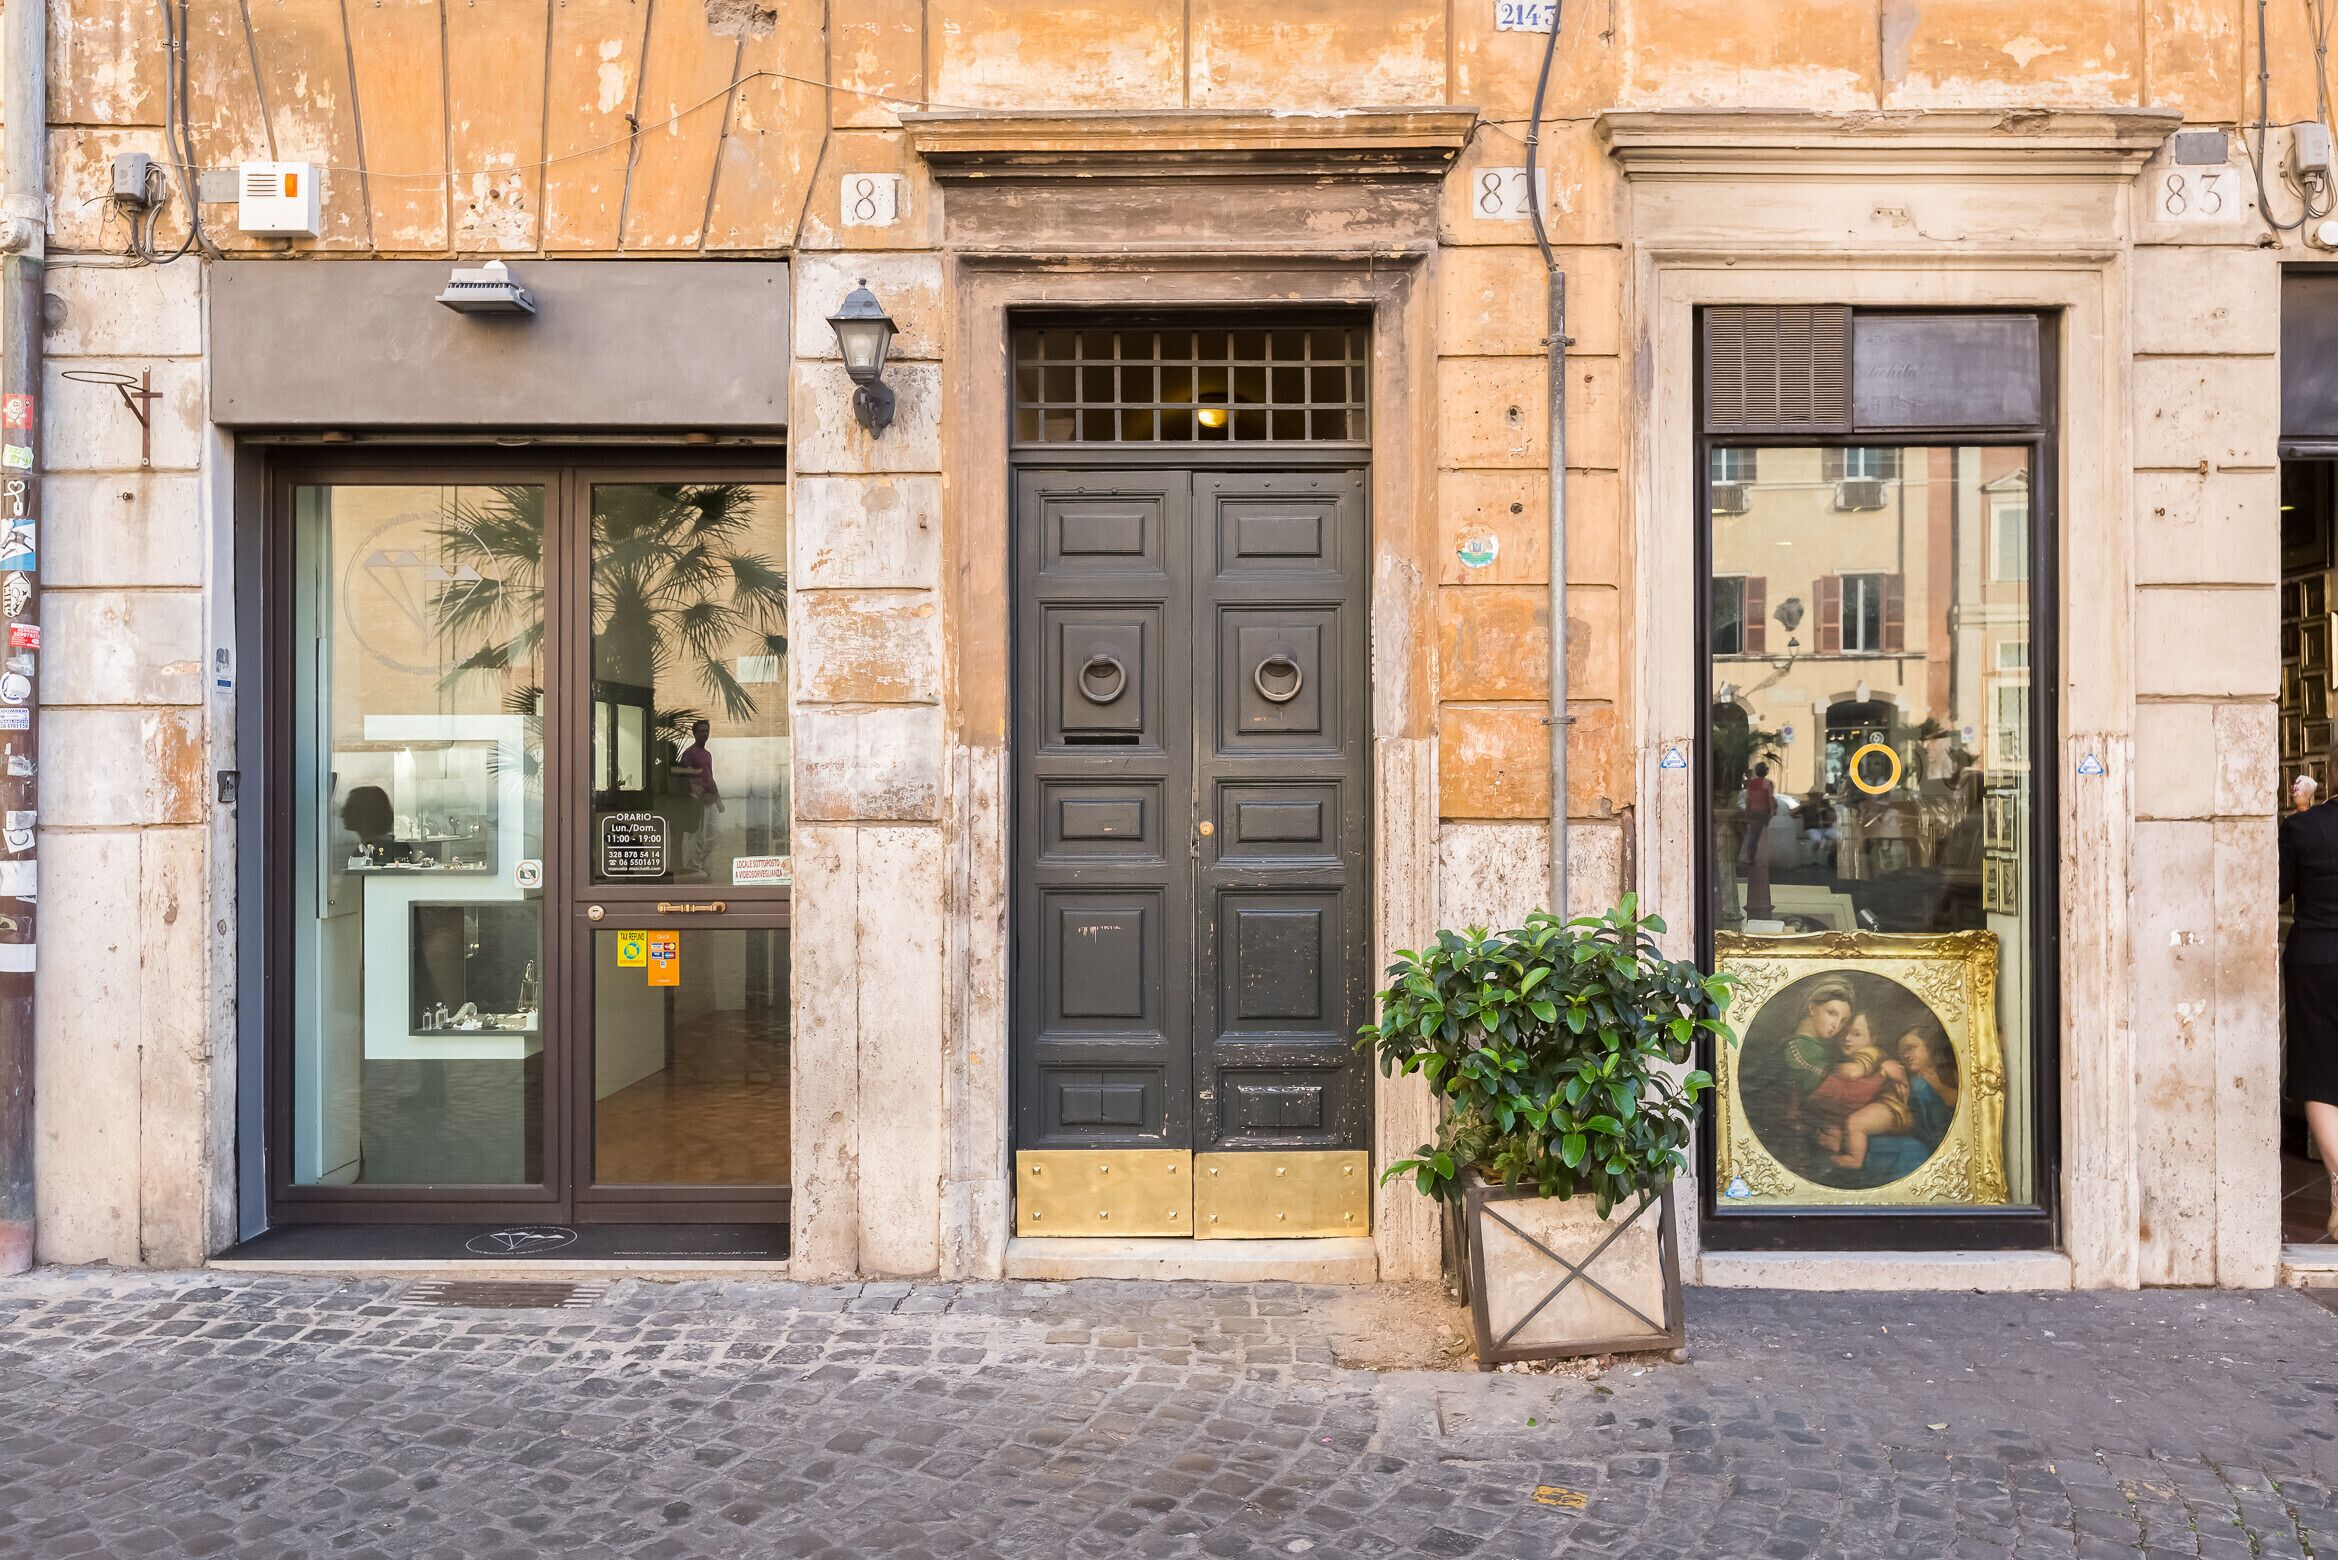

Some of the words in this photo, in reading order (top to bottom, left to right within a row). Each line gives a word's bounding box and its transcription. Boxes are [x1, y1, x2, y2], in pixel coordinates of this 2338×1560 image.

[1501, 3, 1556, 26] 2143
[1480, 172, 1531, 214] 82
[2165, 173, 2222, 216] 83
[855, 178, 902, 221] 81
[616, 813, 651, 821] ORARIO
[611, 824, 656, 833] Lun./Dom.
[607, 835, 630, 843] 11:00
[639, 835, 661, 843] 19:00
[752, 858, 780, 868] SOTTOPOSTO
[739, 869, 783, 878] VIDEOSORVEGLIANZA
[629, 932, 645, 940] REFUND
